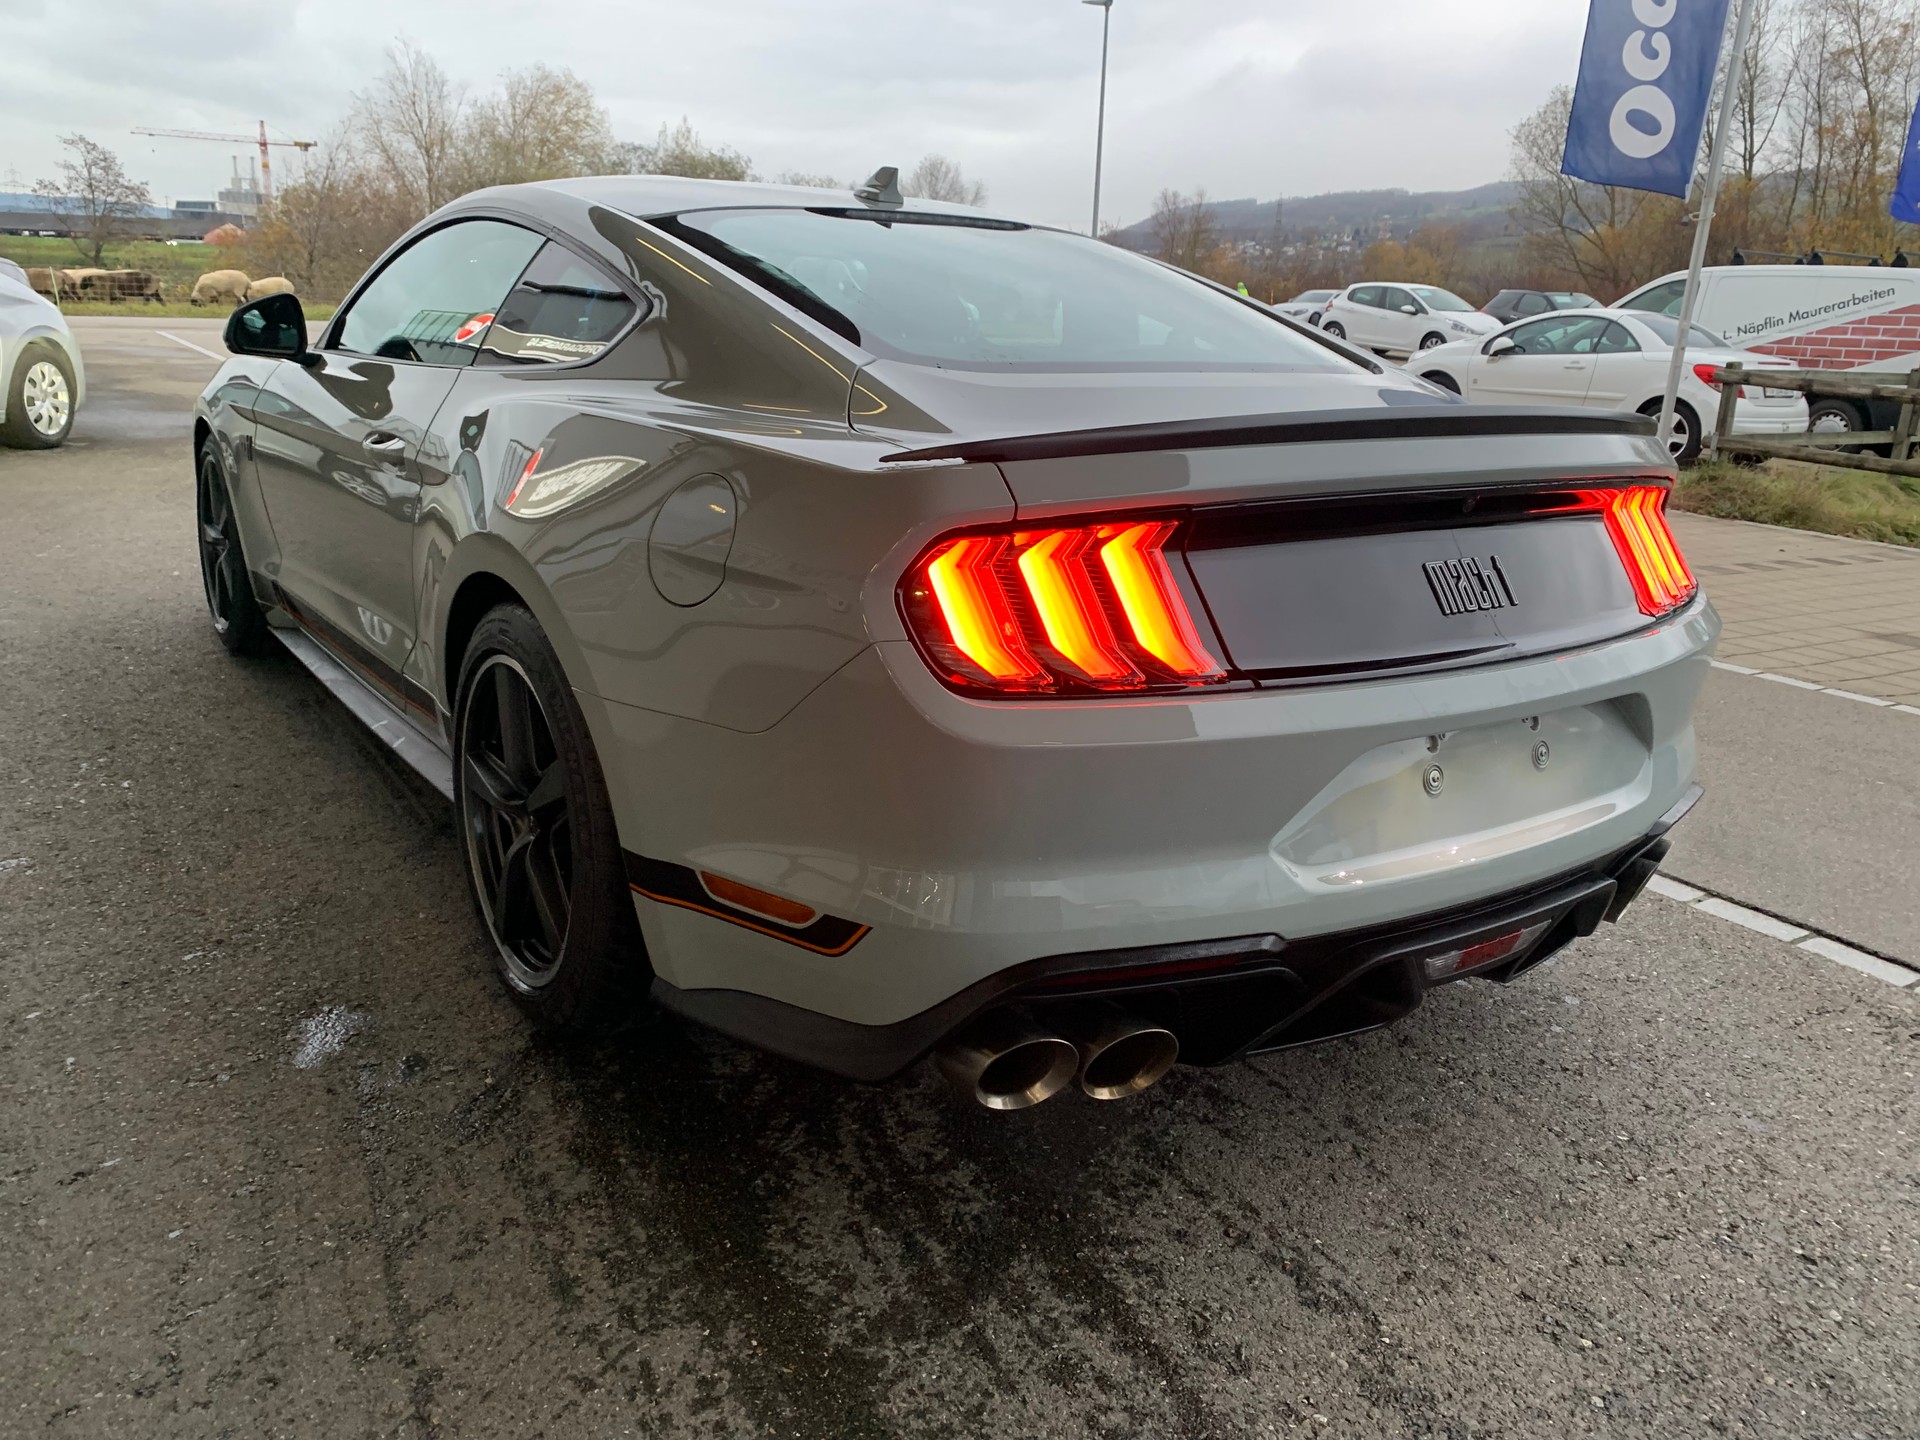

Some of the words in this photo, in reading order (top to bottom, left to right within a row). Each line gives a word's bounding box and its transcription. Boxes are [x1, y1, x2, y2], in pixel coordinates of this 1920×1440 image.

[1723, 330, 1732, 340] L.
[1737, 315, 1784, 337] Näpflin
[1788, 287, 1895, 324] Maurerarbeiten
